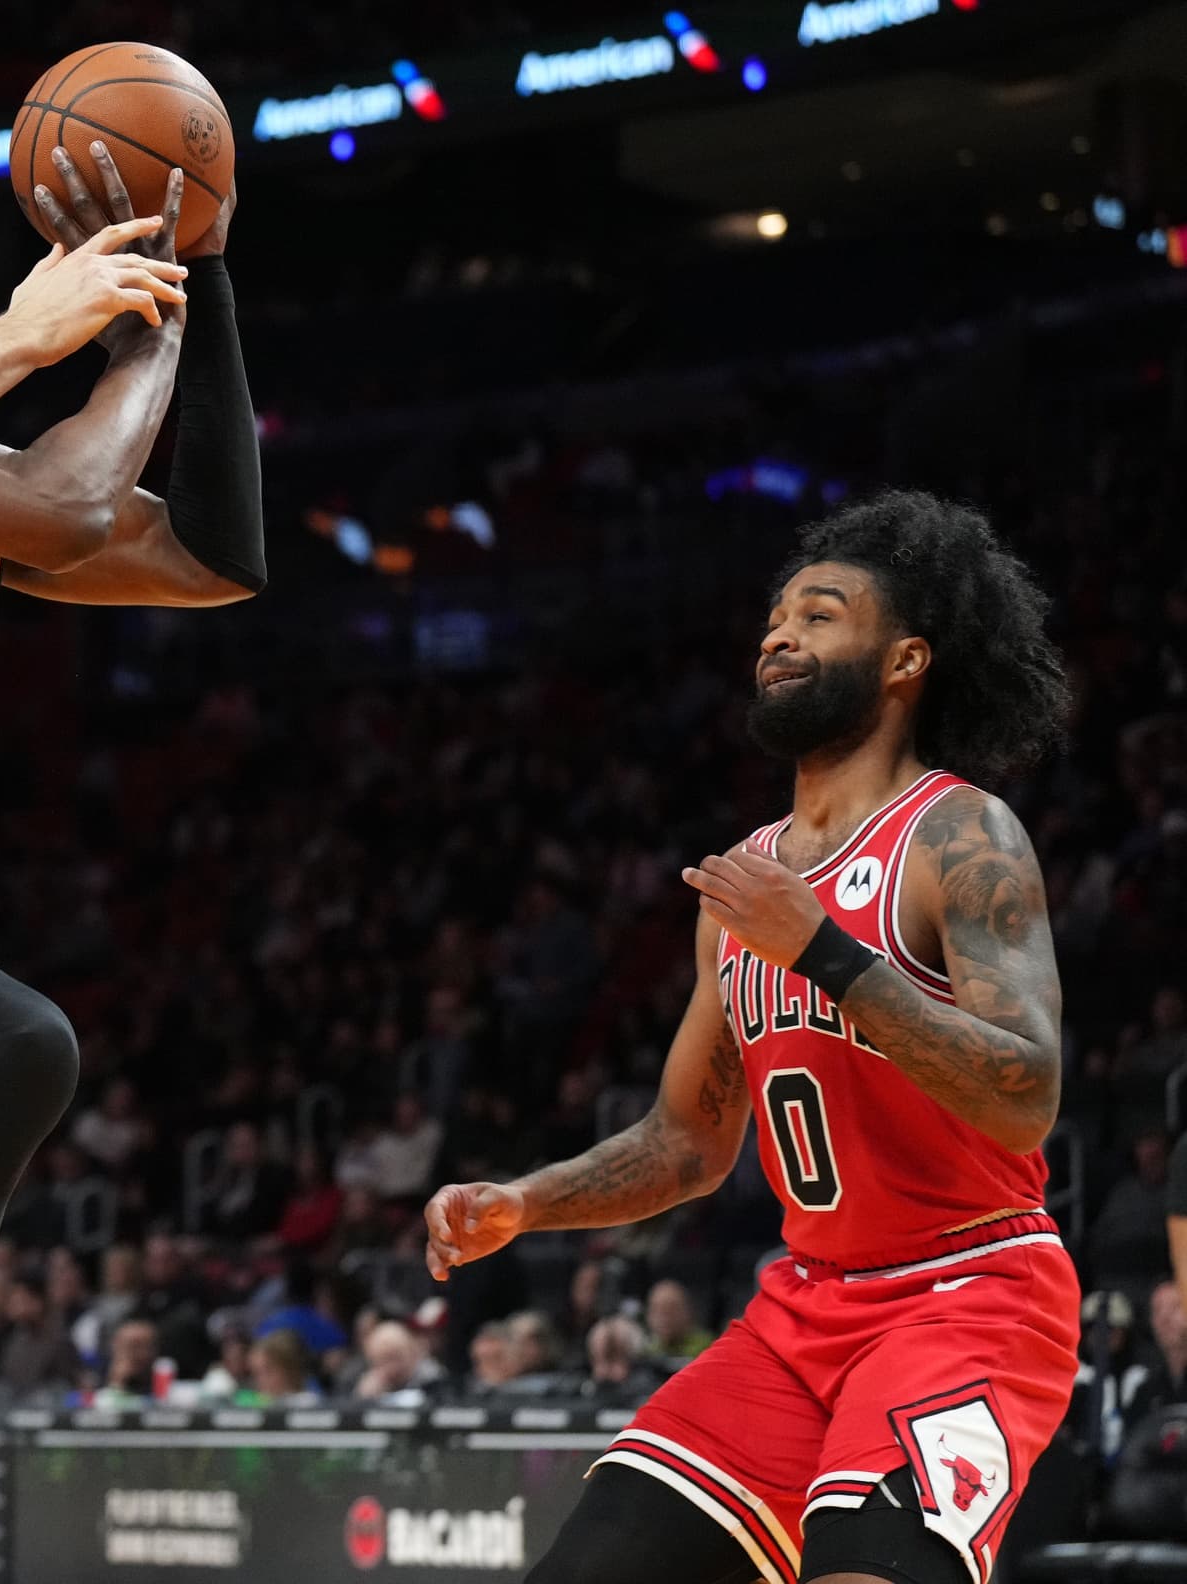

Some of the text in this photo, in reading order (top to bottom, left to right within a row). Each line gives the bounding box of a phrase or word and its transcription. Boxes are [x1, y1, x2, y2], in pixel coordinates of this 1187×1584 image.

[515, 36, 674, 96] American
[254, 84, 404, 142] American
[762, 1067, 843, 1212] 0
